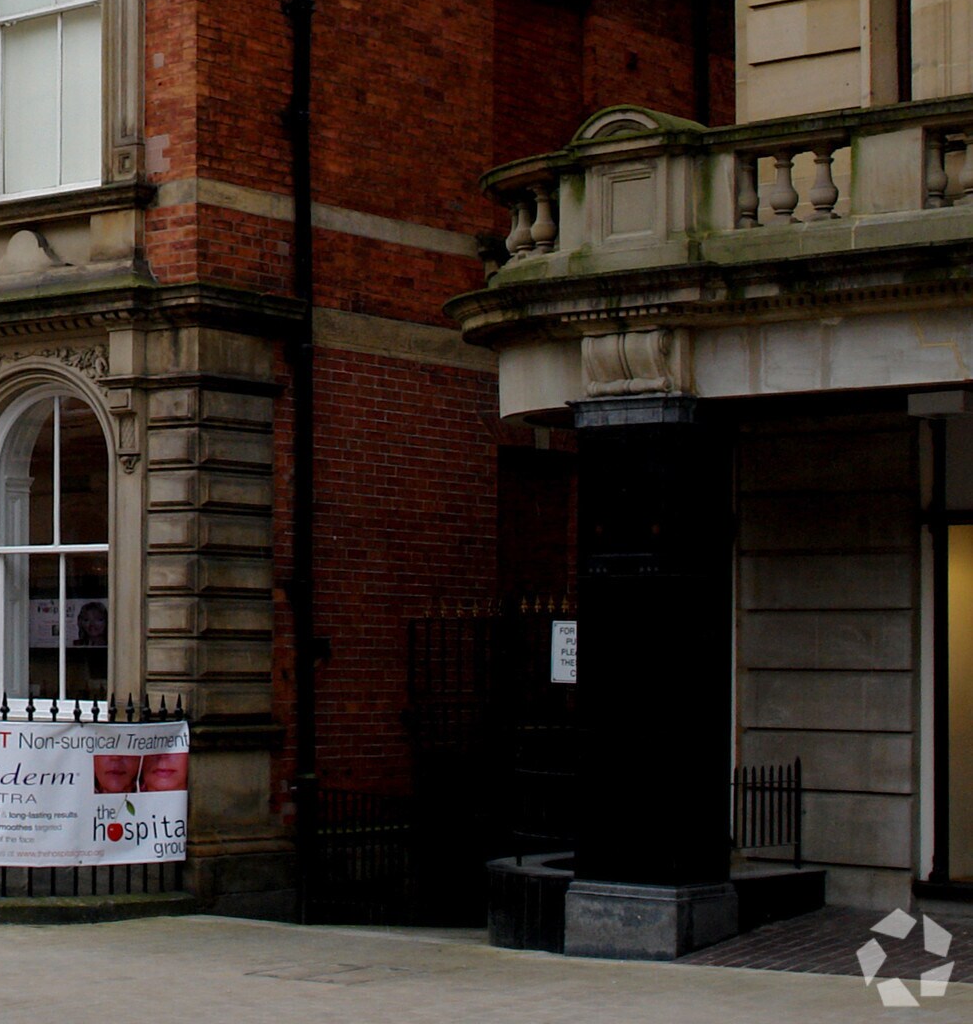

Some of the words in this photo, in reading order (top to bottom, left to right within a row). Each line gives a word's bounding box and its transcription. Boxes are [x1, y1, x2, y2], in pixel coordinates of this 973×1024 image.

[560, 627, 575, 635] FOR
[19, 732, 121, 753] Non-surgical
[9, 811, 52, 821] long-lasting
[96, 803, 116, 820] the
[93, 814, 186, 846] hospita
[5, 835, 17, 843] the
[153, 841, 186, 858] grou
